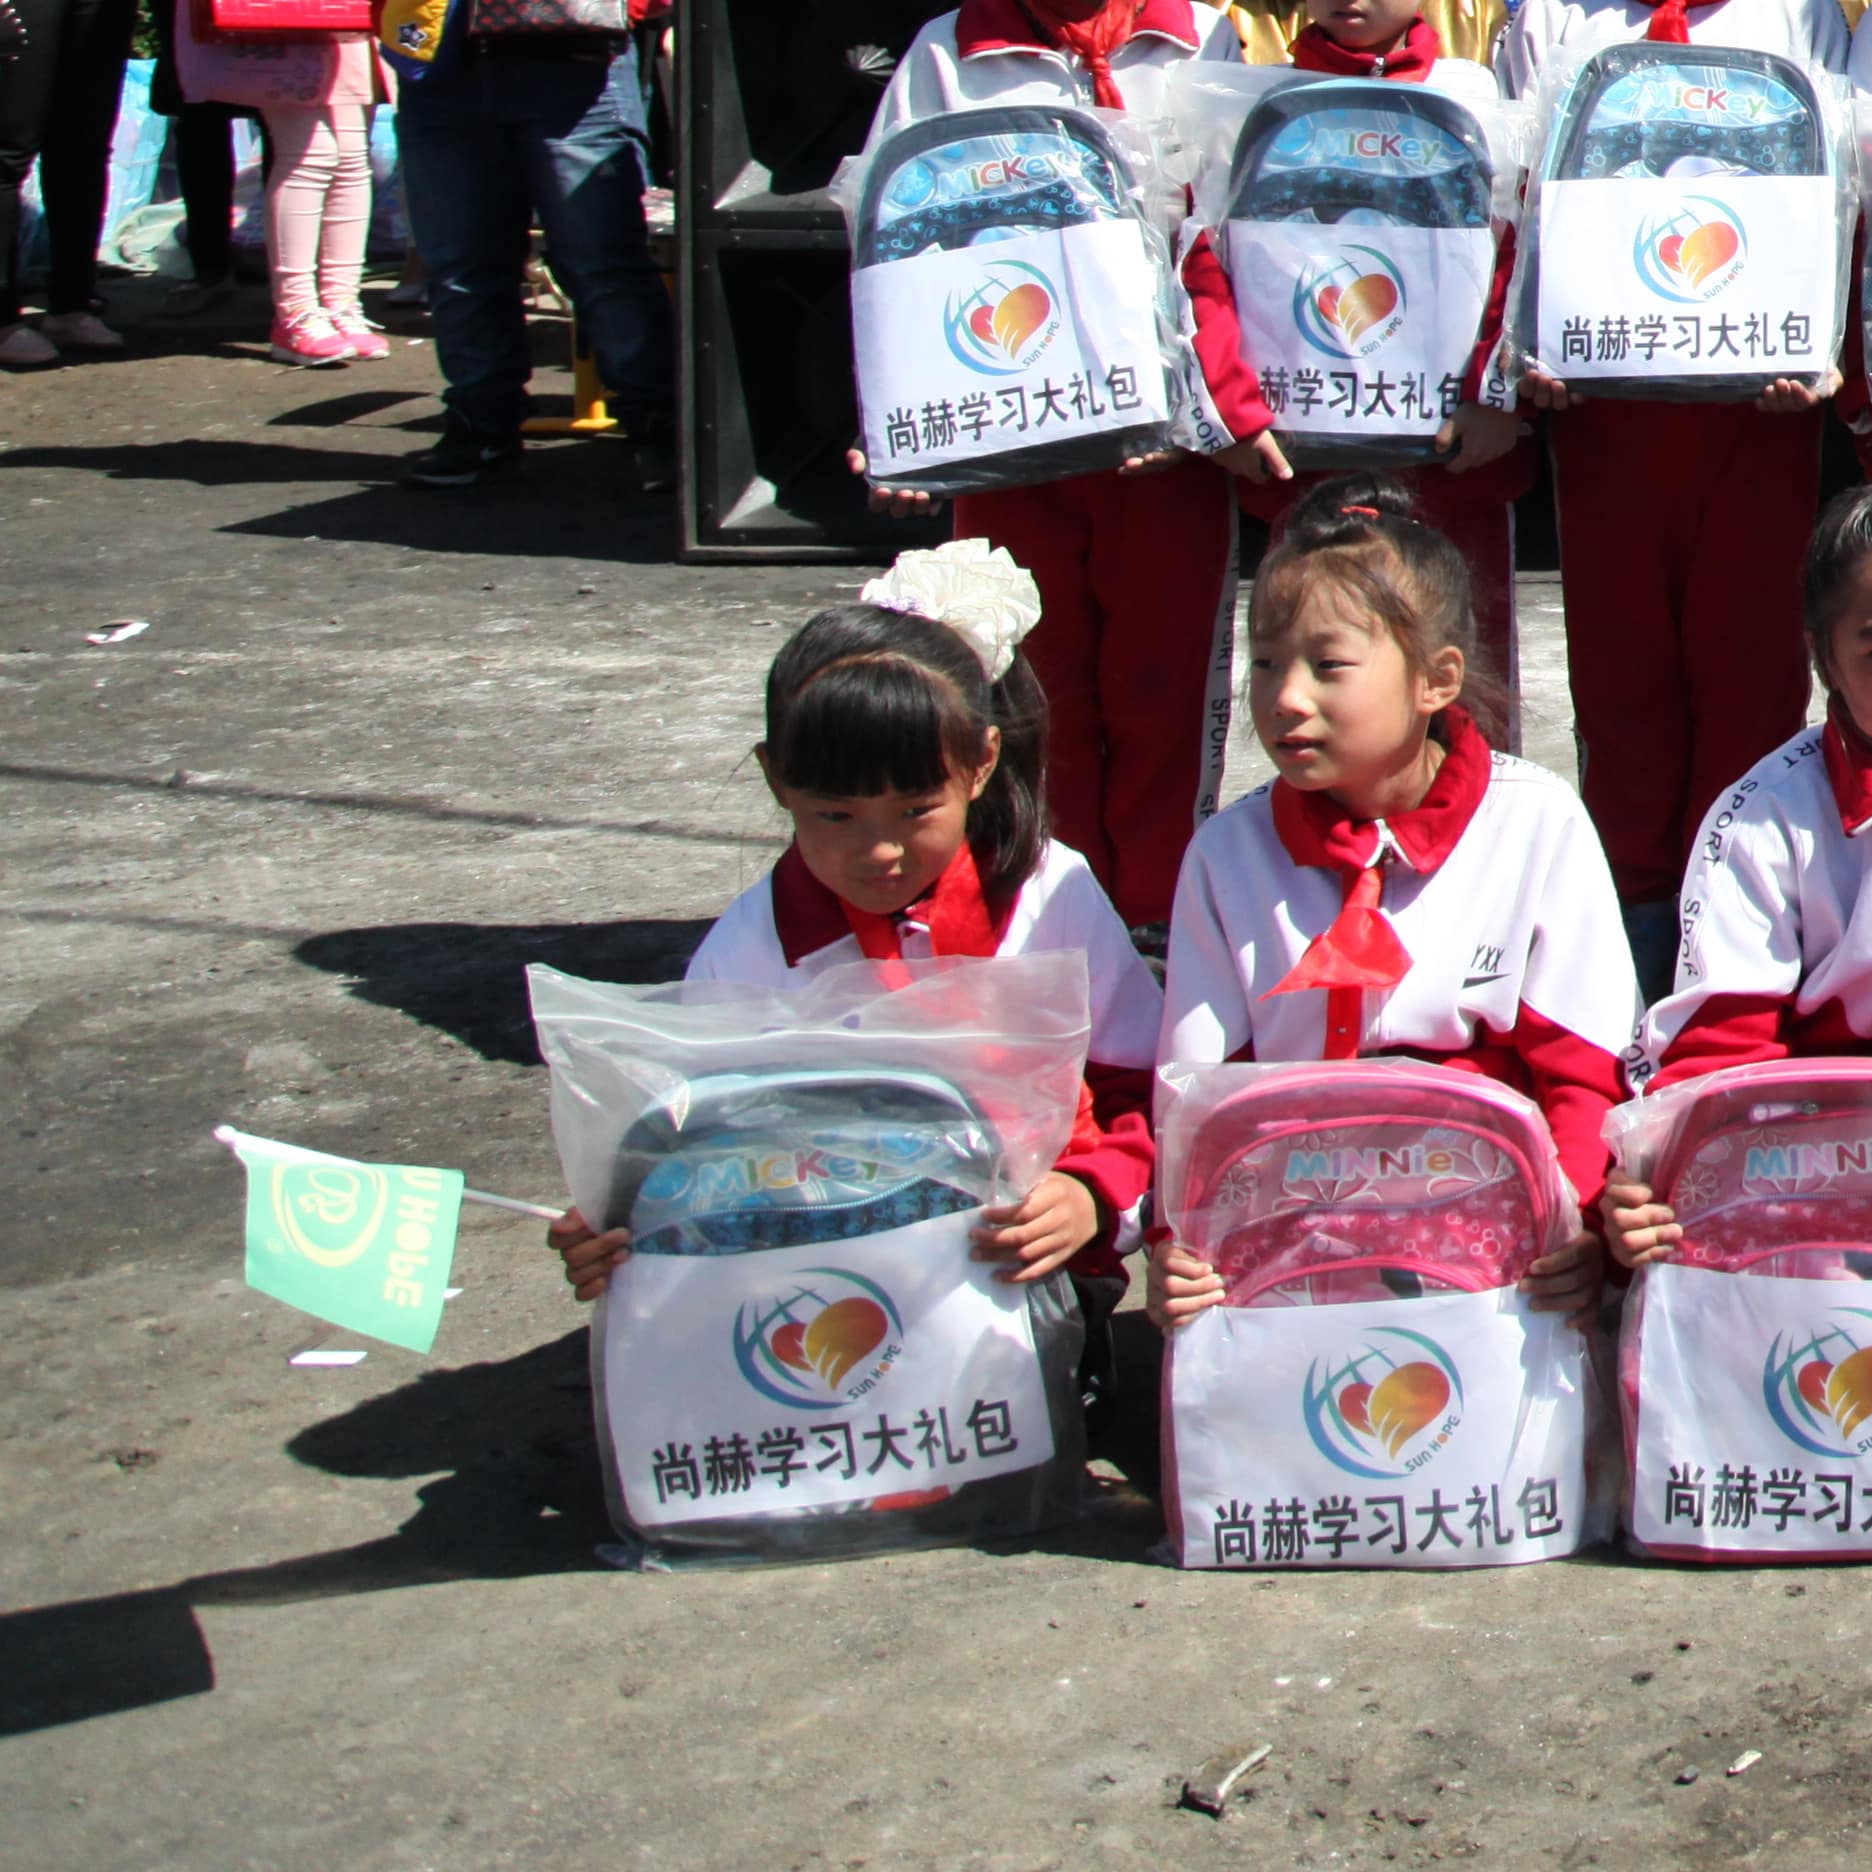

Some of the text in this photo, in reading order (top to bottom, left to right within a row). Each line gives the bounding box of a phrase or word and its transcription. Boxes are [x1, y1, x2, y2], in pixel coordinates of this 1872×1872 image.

[1561, 309, 1813, 364] 尚赫学习大礼包
[886, 362, 1143, 459] 尚赫学习大礼包
[1259, 364, 1465, 420] 赫学习大礼包
[1700, 777, 1758, 869] SPORT
[651, 1397, 1020, 1505] 尚赫学习大礼包
[1213, 1476, 1565, 1565] 尚赫学习大礼包
